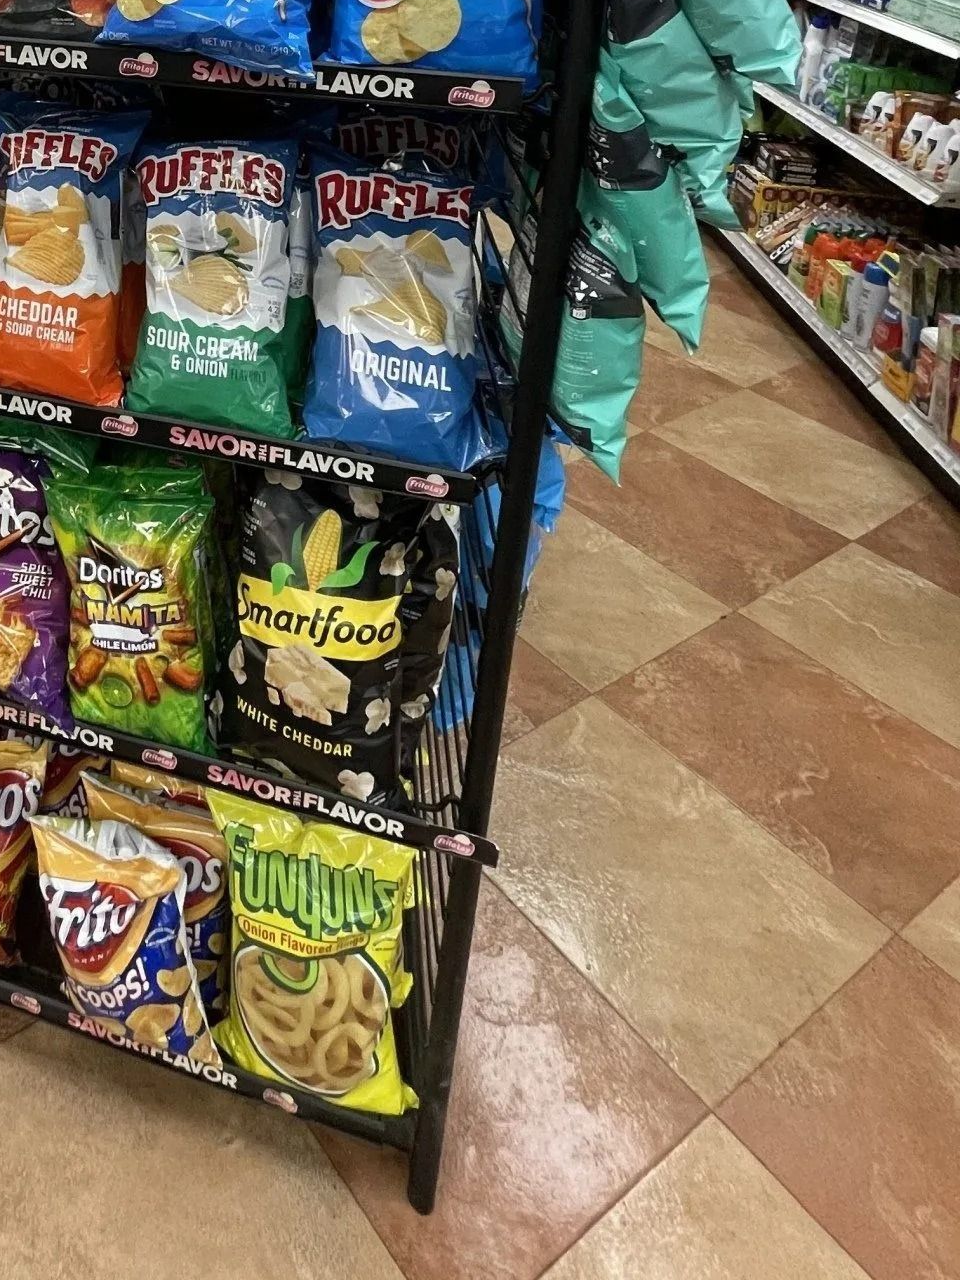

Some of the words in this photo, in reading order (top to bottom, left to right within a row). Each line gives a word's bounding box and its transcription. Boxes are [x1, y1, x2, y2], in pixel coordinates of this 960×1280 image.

[315, 170, 474, 231] RUFFLES
[5, 321, 33, 337] SOUR
[36, 326, 75, 344] CREAM
[147, 325, 190, 348] SOUR
[195, 336, 258, 362] CREAM
[171, 357, 181, 371] &
[186, 357, 228, 378] ONION
[351, 349, 452, 392] ORIGINAL
[169, 426, 256, 460] SAVOR
[269, 445, 375, 483] FLAVOR
[11, 572, 54, 587] SWEET
[79, 556, 164, 591] Doritos
[21, 586, 52, 600] CHILI
[238, 581, 397, 648] Smartfood
[121, 638, 157, 652] LIMÓN
[236, 694, 277, 732] WHITE
[282, 724, 352, 757] CHEDDAR
[206, 765, 291, 805] SAVOR
[303, 792, 405, 838] FLAVOR
[40, 872, 137, 948] Frito
[243, 919, 276, 944] Onion
[280, 933, 333, 955] Flavored
